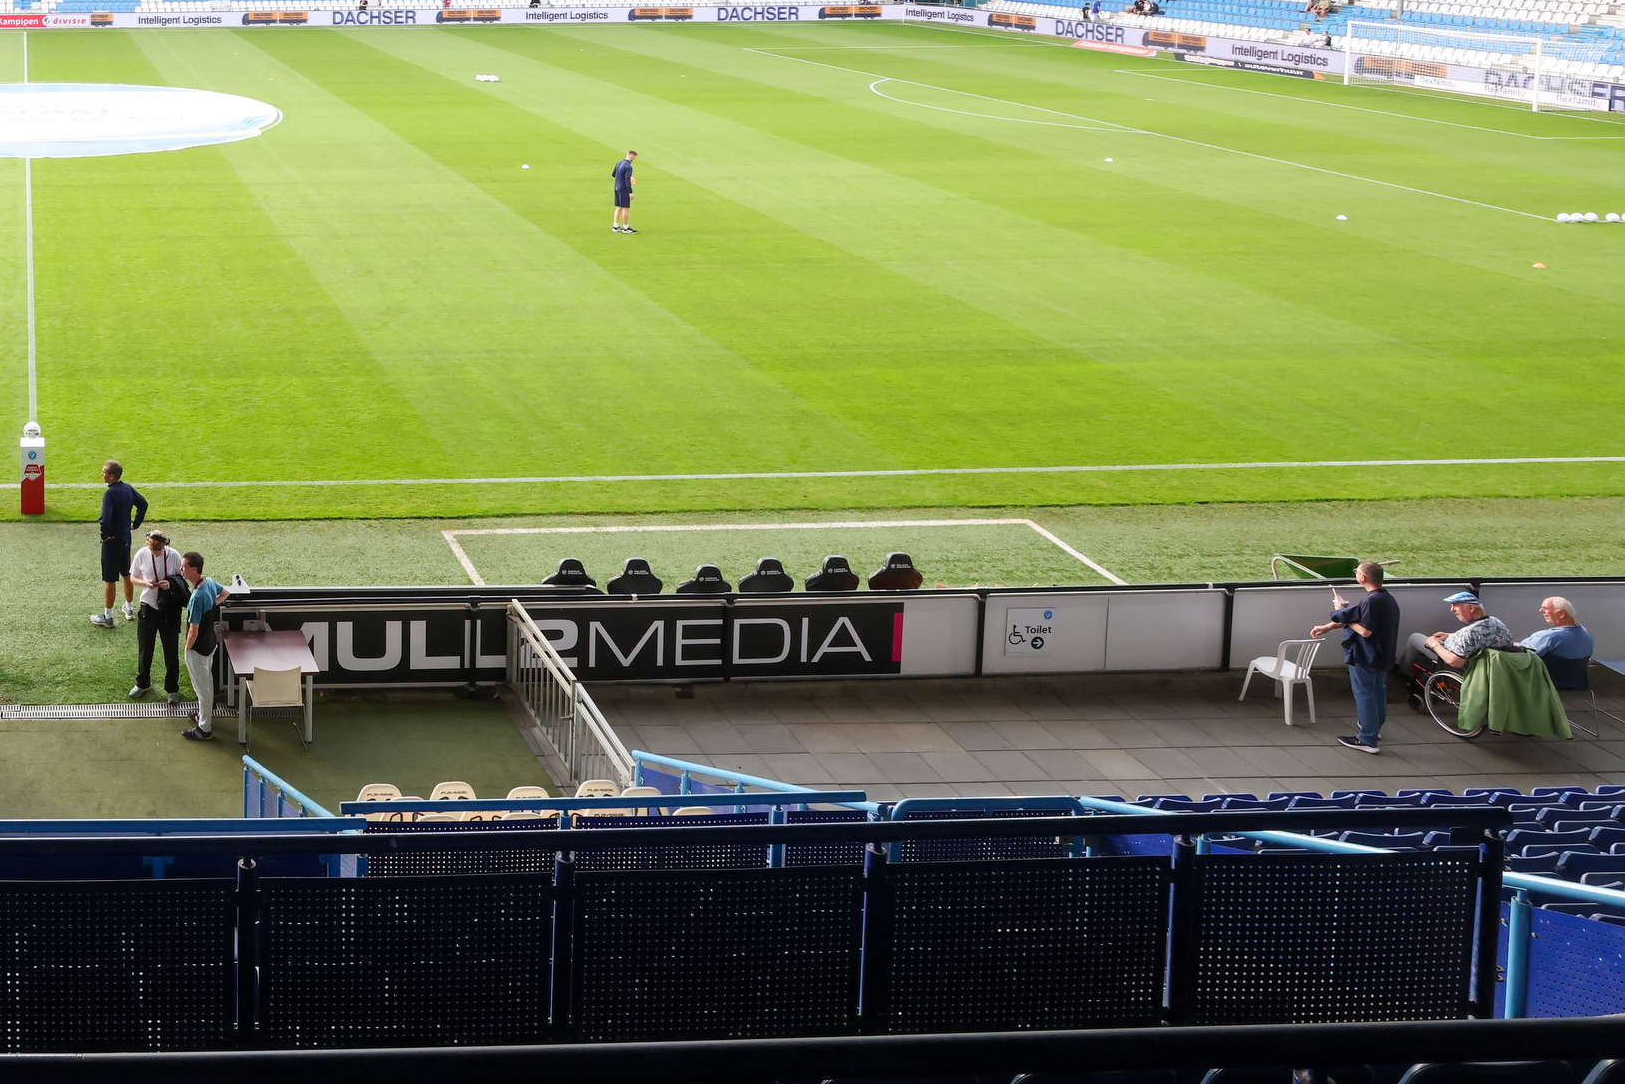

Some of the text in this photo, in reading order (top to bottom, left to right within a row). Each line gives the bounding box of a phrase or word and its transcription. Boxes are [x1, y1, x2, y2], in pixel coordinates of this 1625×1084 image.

[138, 16, 222, 25] Intelligent Logistics
[332, 10, 416, 25] DACHSER
[525, 11, 609, 21] Intelligent Logistics
[717, 6, 799, 21] DACHSER
[905, 8, 975, 22] Intelligent Logistics
[1055, 20, 1125, 44] DACHSER
[1231, 44, 1329, 67] Intelligent Logistics
[1420, 75, 1457, 88] flexfamily
[1484, 84, 1526, 98] flexfamily
[1556, 93, 1602, 109] flexfamily
[1025, 625, 1052, 634] Toilet
